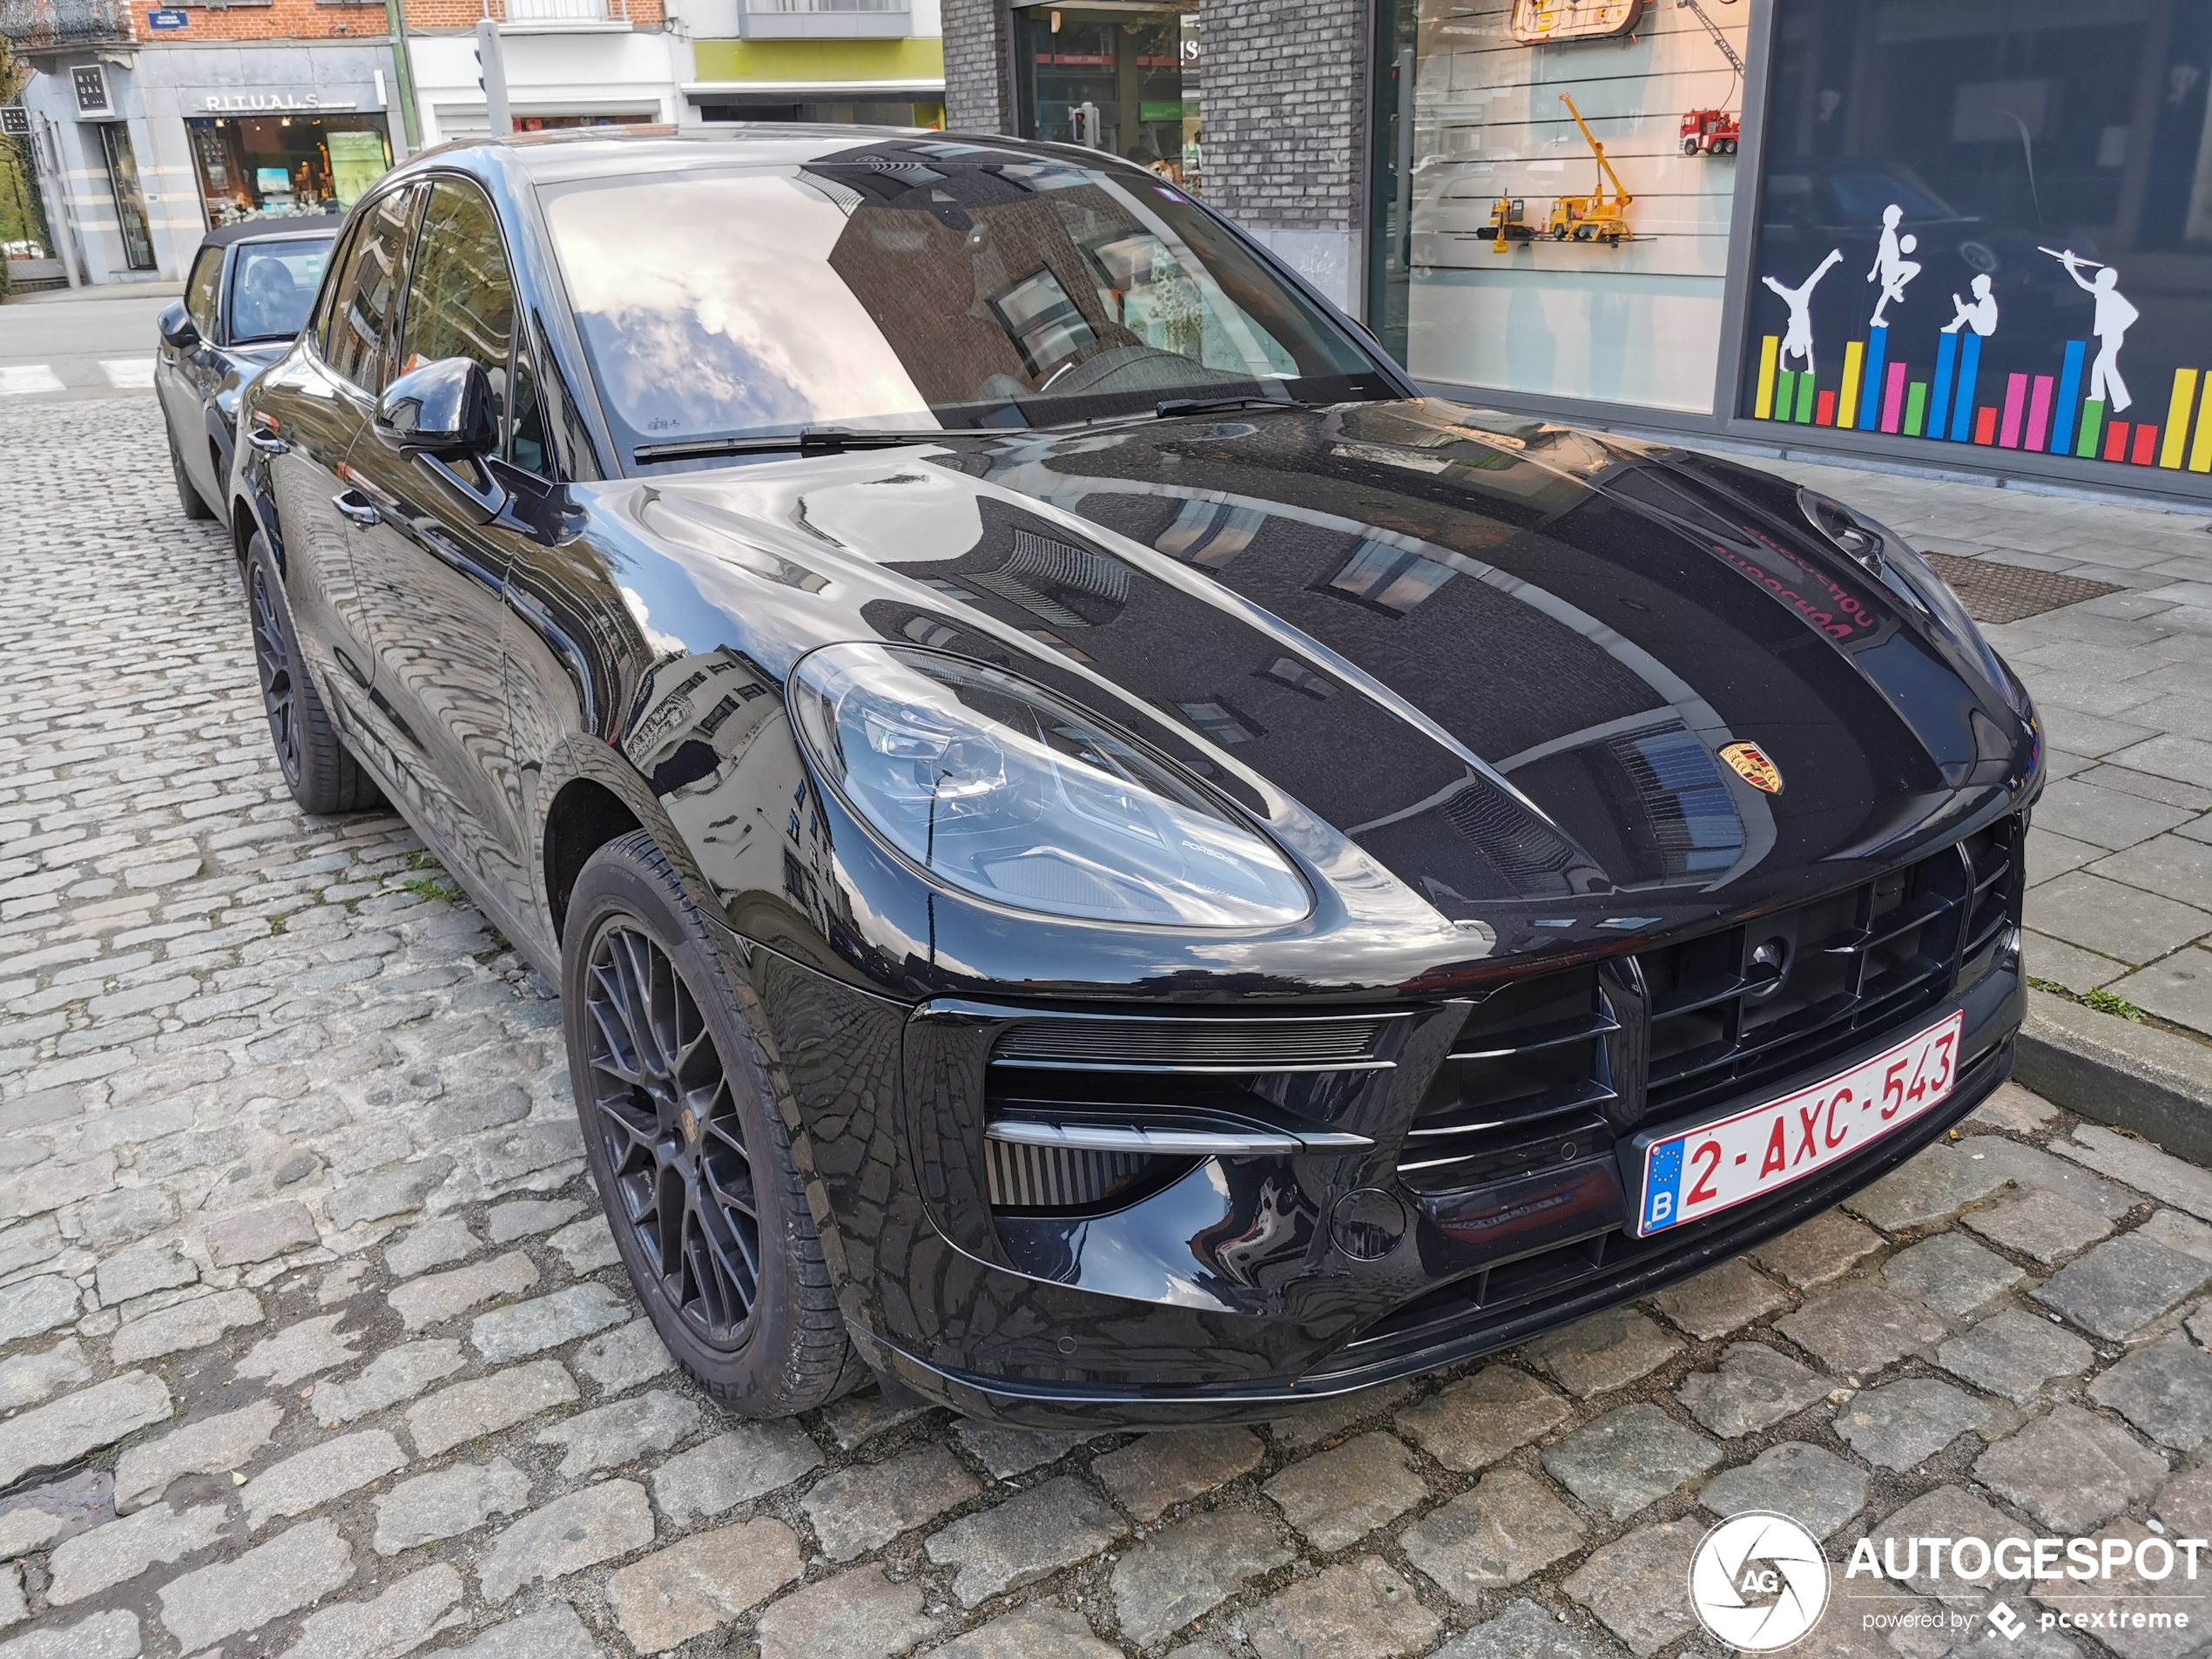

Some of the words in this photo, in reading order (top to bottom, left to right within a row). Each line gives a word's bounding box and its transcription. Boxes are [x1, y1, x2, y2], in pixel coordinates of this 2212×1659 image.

[1182, 840, 1239, 865] PORSCHE
[1686, 1030, 1955, 1207] 2-AXC-543
[1650, 1190, 1673, 1223] B
